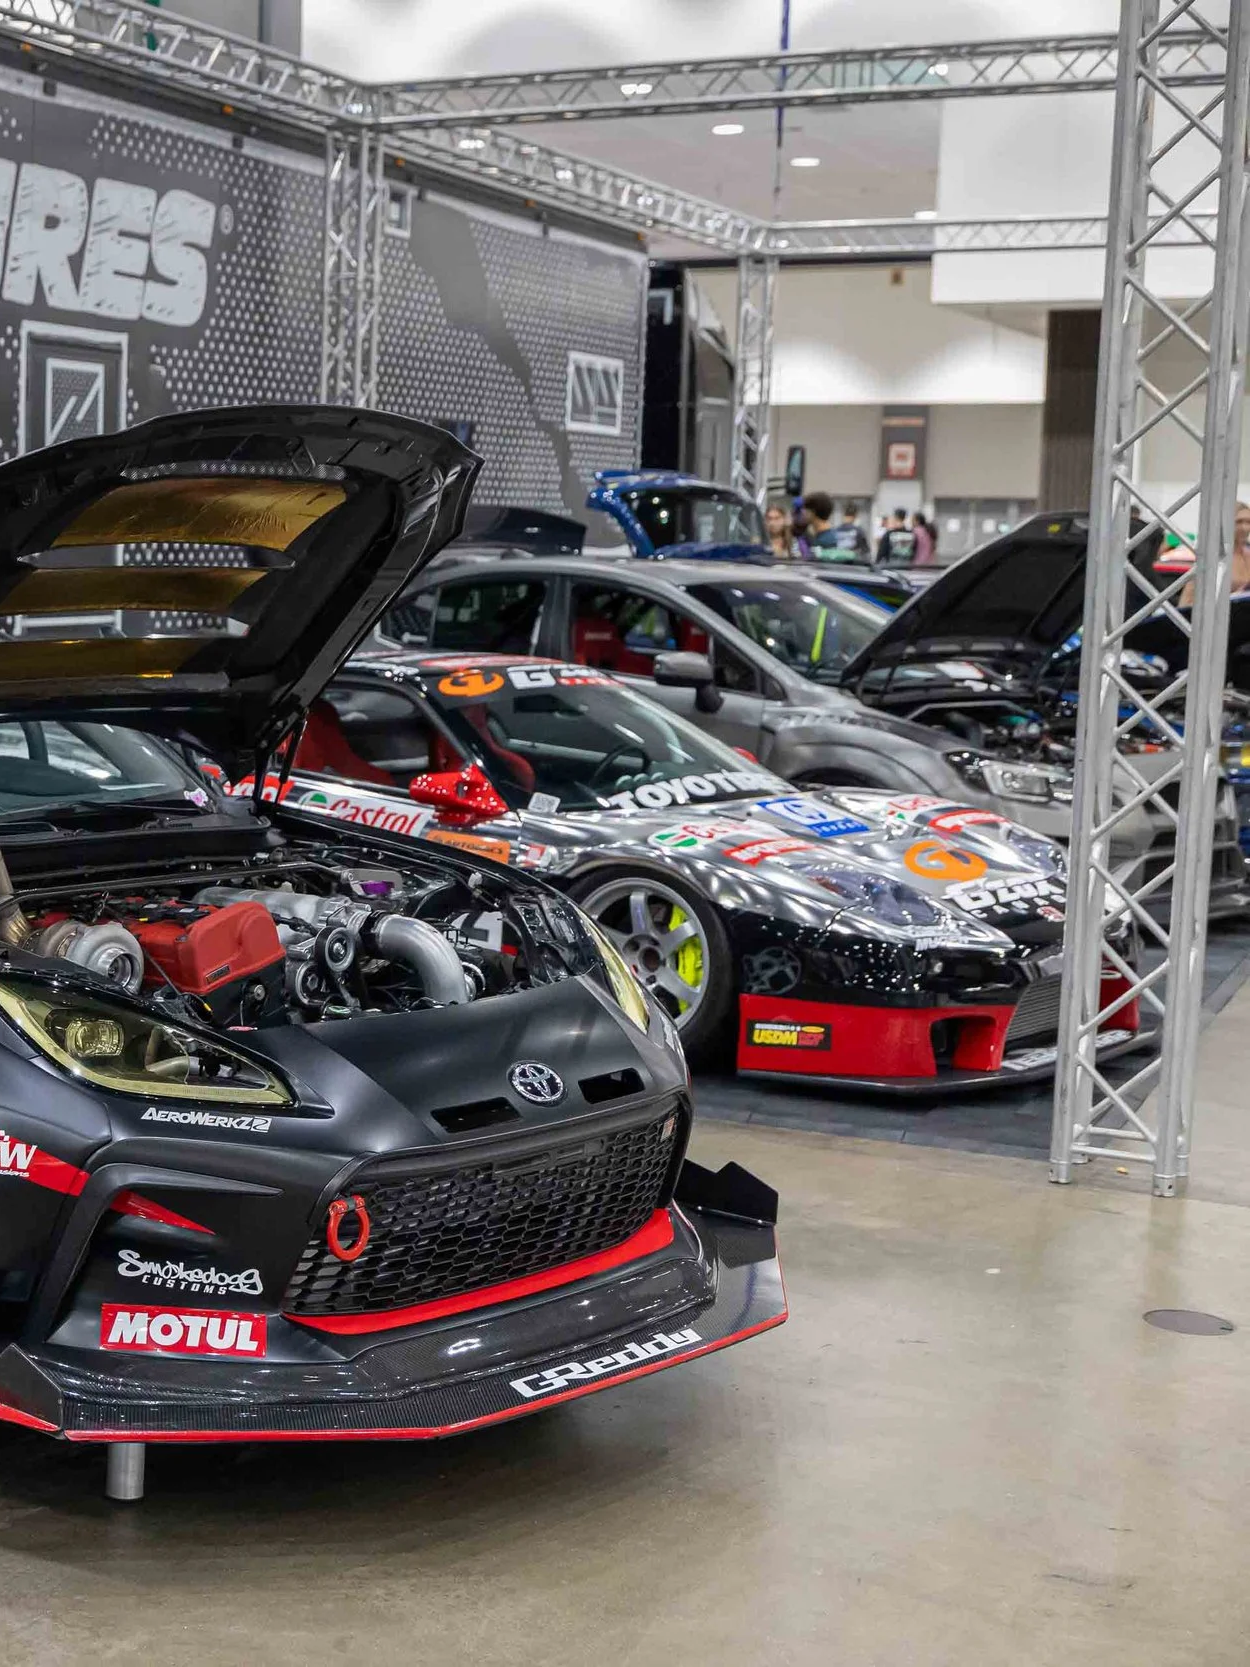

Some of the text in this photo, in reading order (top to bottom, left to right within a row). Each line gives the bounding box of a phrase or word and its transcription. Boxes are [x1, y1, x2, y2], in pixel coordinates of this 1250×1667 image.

[607, 774, 718, 811] TOYO
[327, 798, 422, 836] Castrol
[141, 1274, 228, 1295] CUSTOMS
[107, 1311, 259, 1351] MOTUL
[509, 1328, 702, 1398] GReddy
